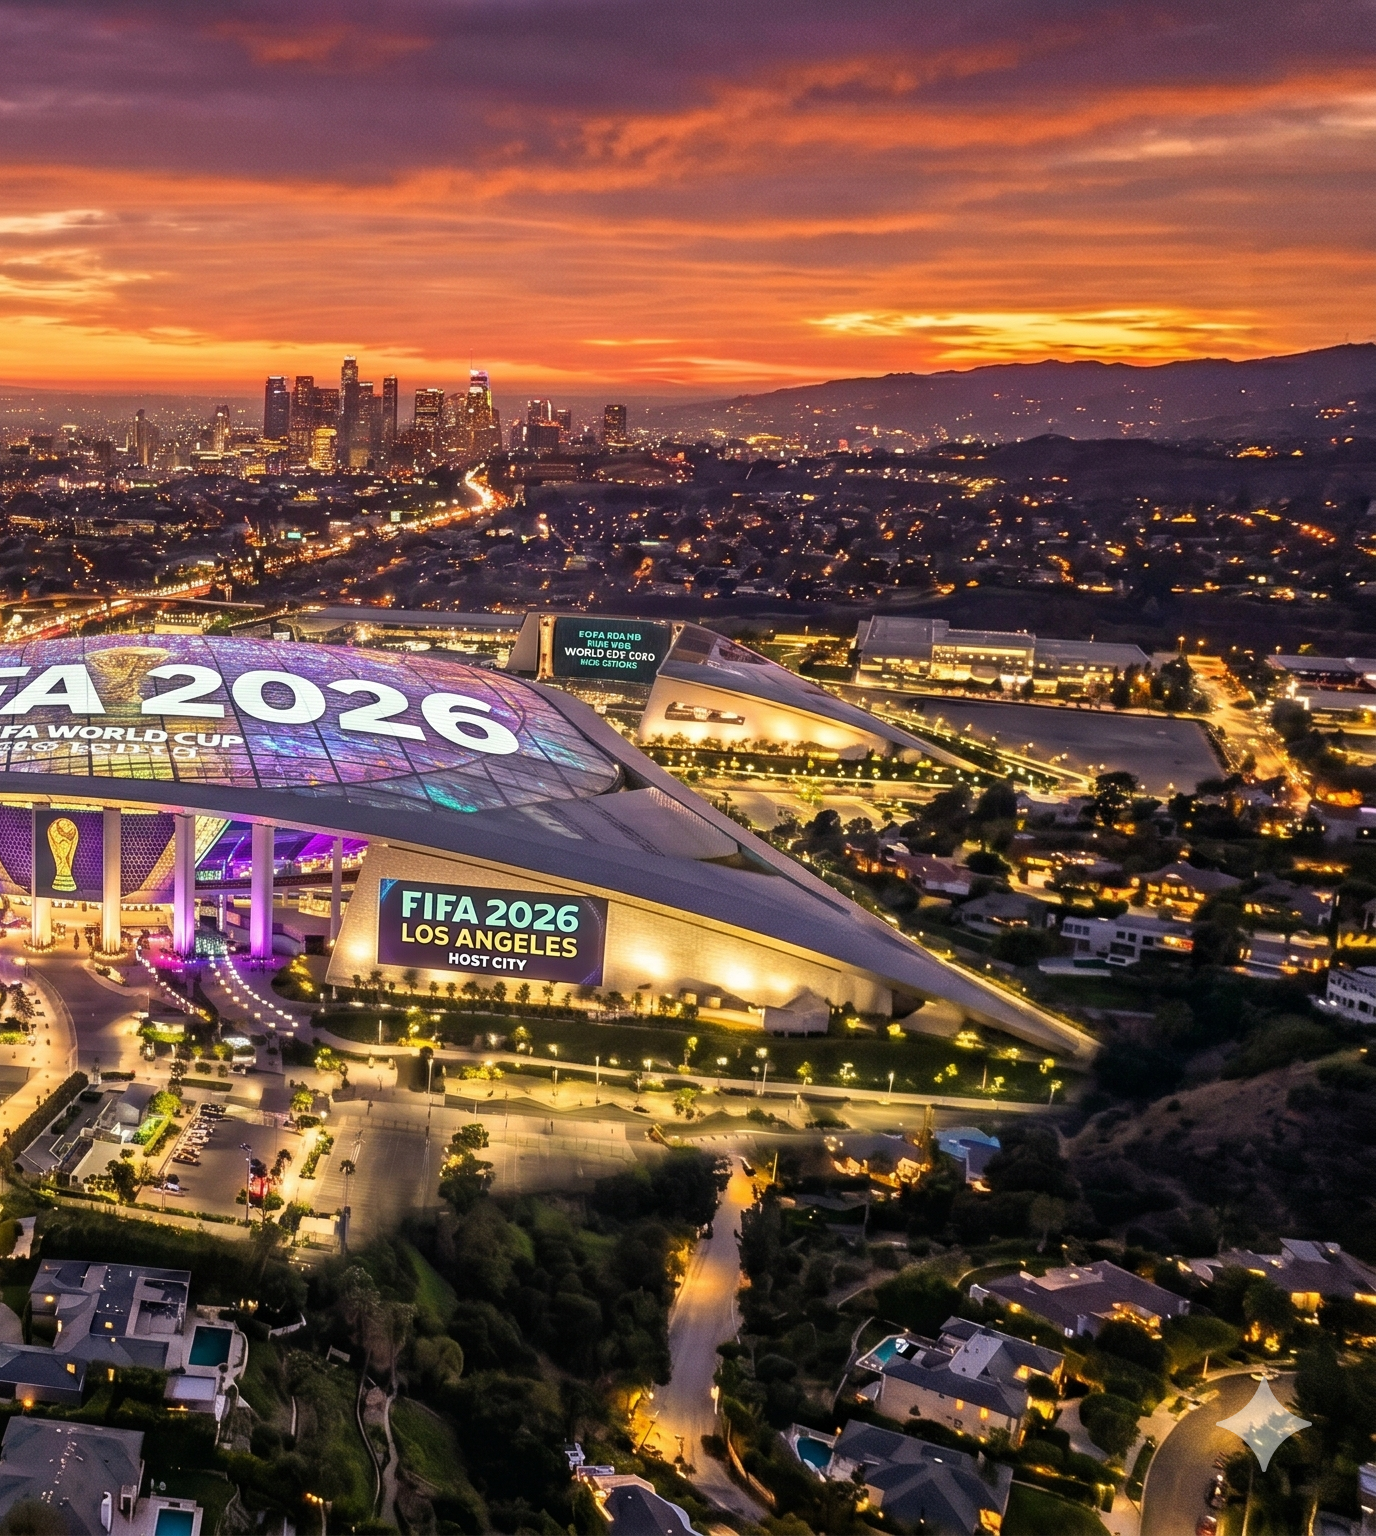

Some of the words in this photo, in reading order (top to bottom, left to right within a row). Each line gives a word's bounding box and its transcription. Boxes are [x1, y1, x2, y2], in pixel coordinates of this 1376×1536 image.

[564, 647, 604, 658] WORLD
[140, 664, 519, 755] 2026
[48, 725, 168, 743] WORLD
[174, 732, 244, 748] CUP
[402, 890, 479, 925] FIFA
[485, 898, 579, 933] 2026
[401, 922, 450, 946] LOS
[455, 928, 578, 959] ANGELES
[448, 953, 490, 968] HOST
[492, 958, 528, 971] CITY
